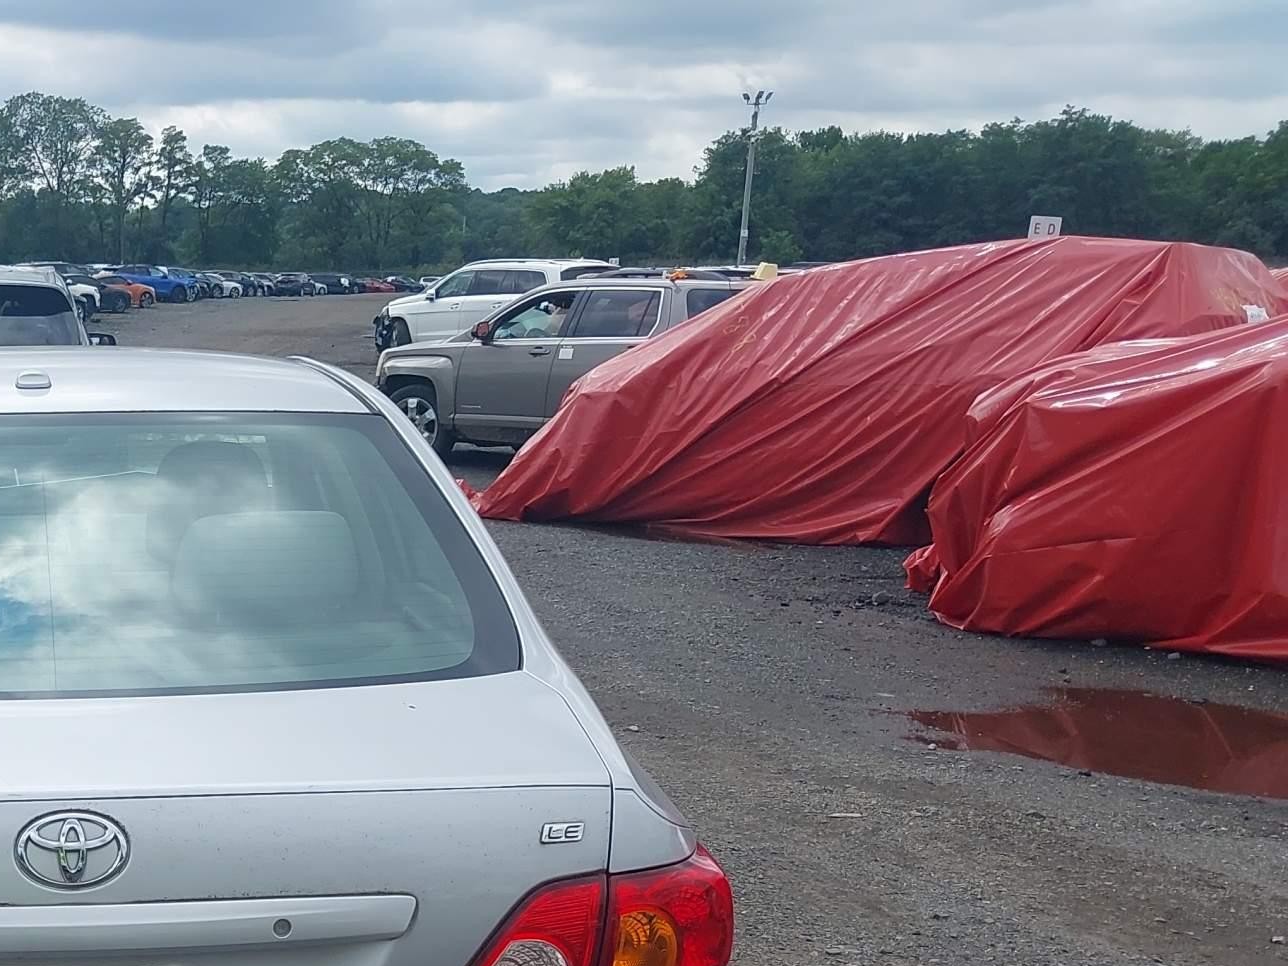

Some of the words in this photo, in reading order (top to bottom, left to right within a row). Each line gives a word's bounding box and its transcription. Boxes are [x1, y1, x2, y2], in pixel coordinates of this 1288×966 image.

[1033, 222, 1041, 235] E
[1047, 223, 1056, 235] D
[543, 823, 583, 841] LE
